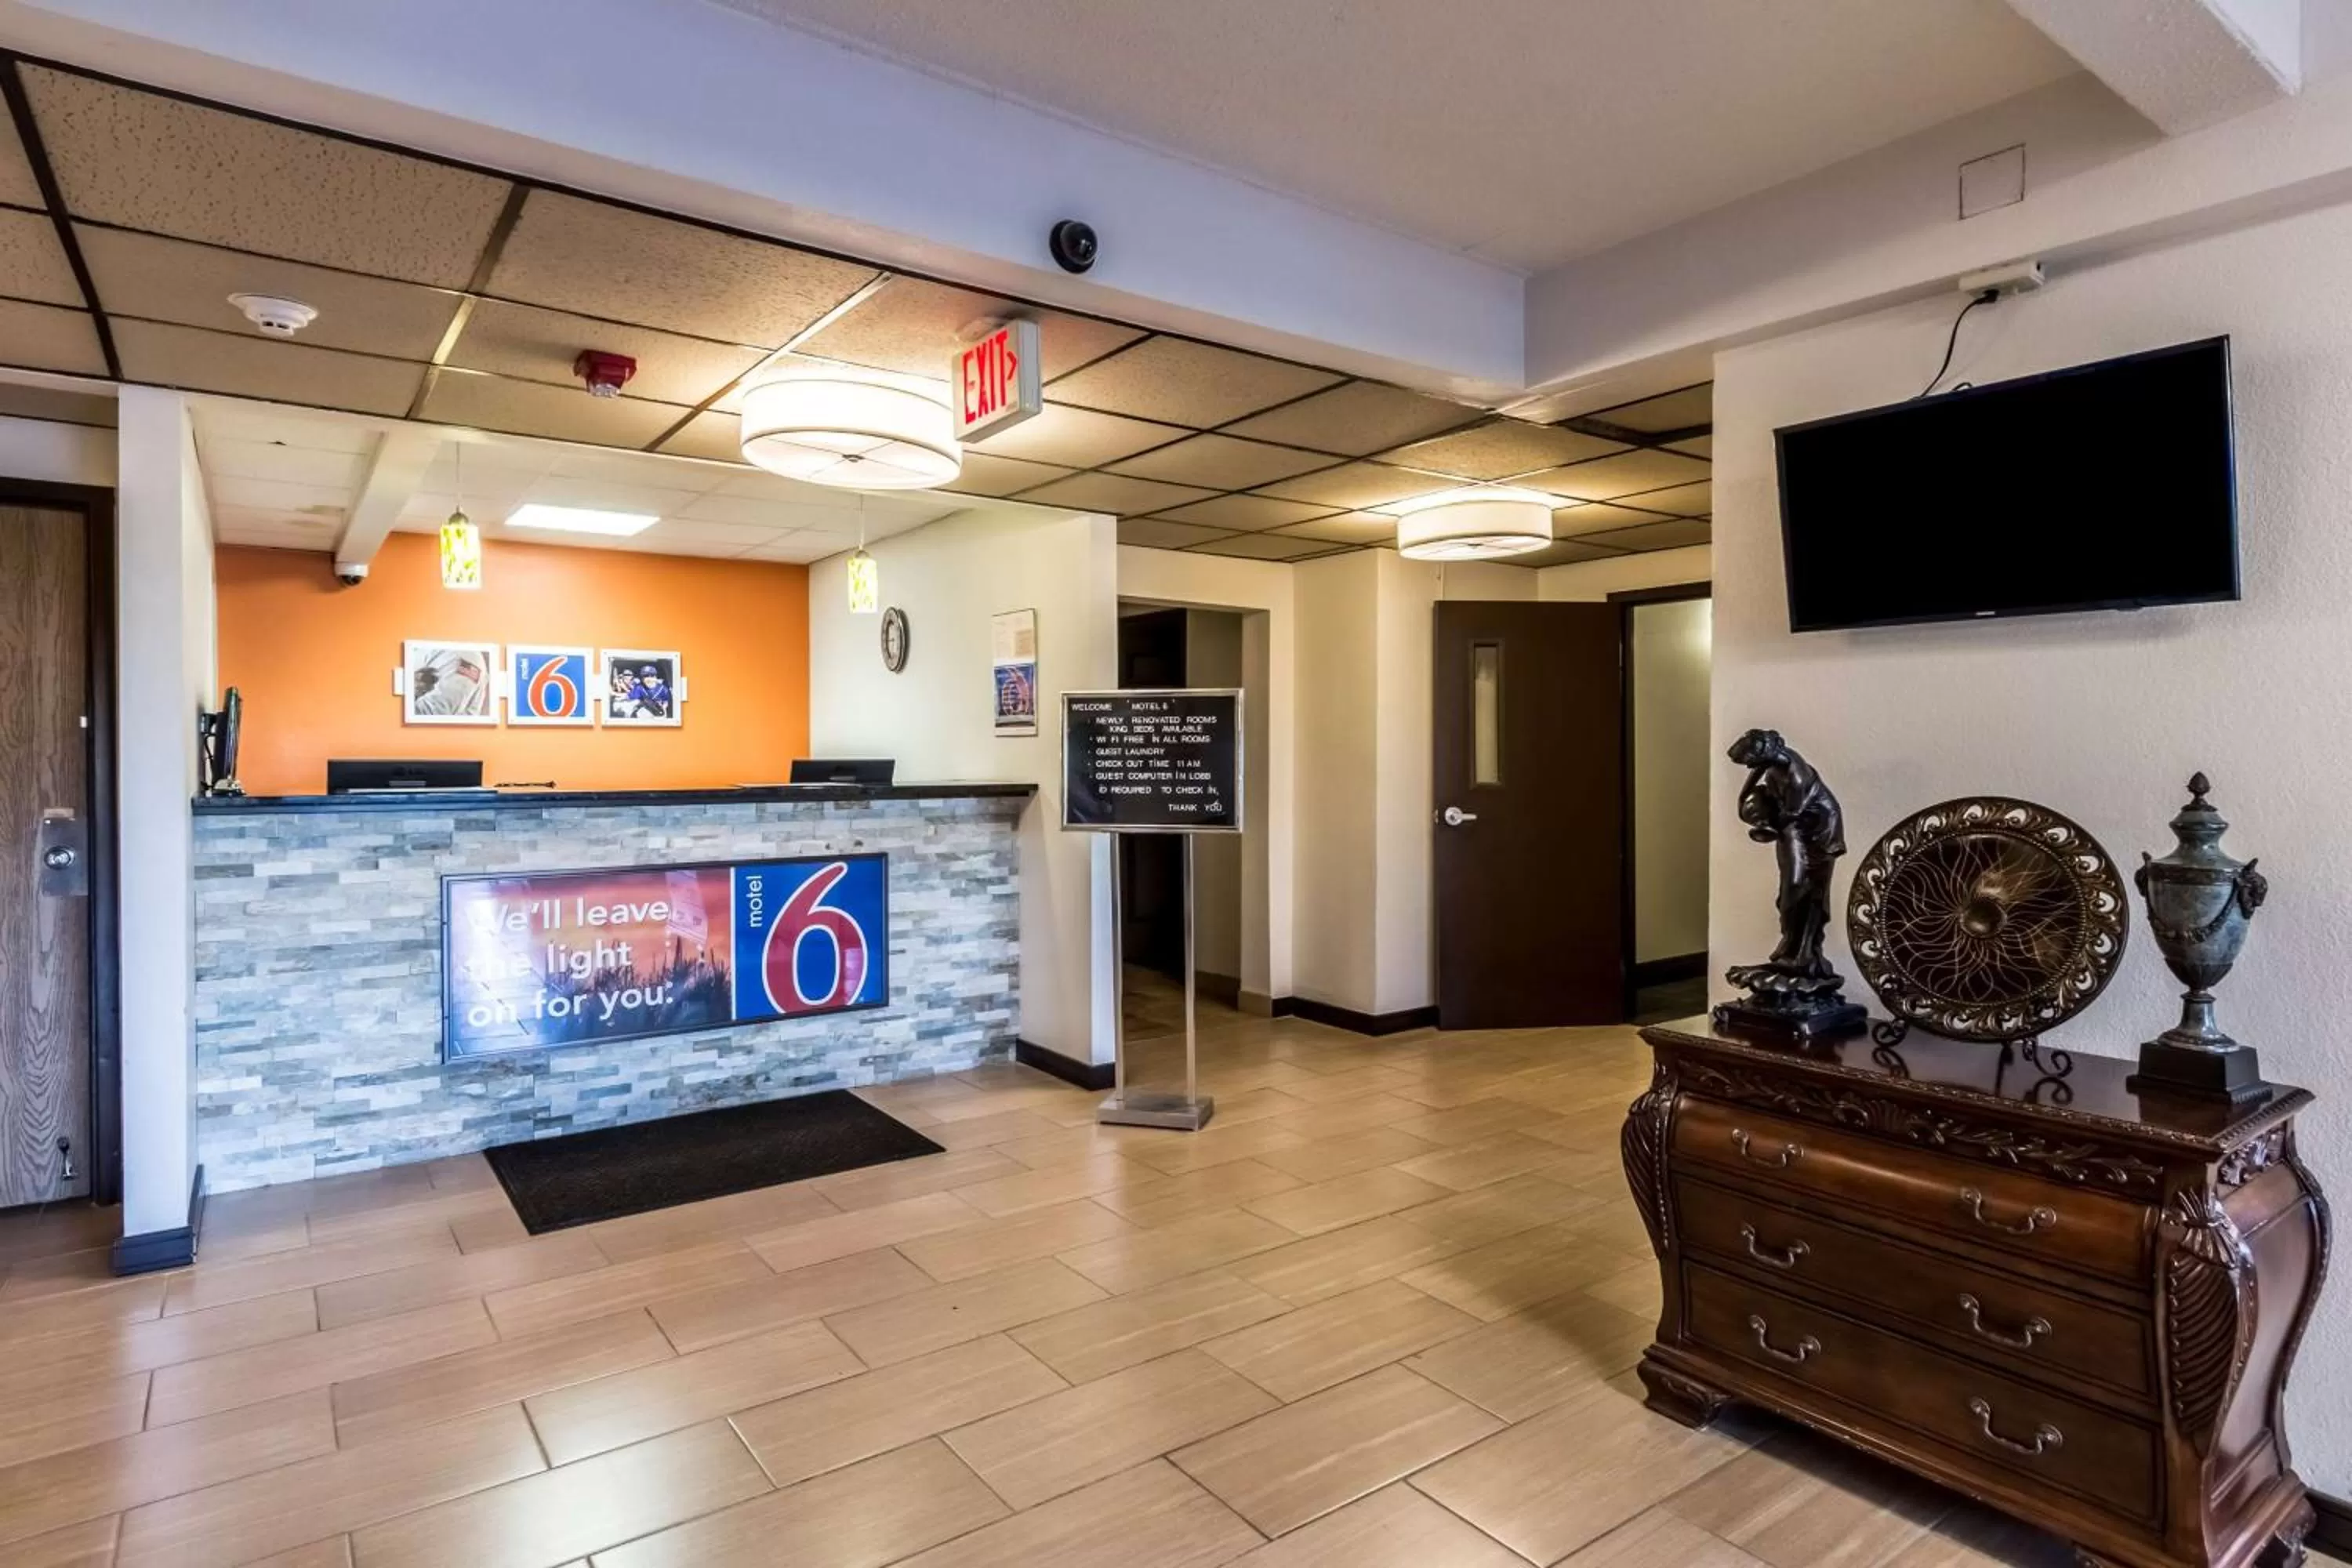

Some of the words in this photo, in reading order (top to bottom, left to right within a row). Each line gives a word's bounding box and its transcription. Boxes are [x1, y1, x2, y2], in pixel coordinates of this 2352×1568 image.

[962, 328, 1009, 424] EXIT
[528, 655, 577, 717] 6
[1072, 702, 1112, 711] WELCOME
[1131, 702, 1160, 710] MOTEL
[1162, 724, 1203, 733] AVAILABLE
[1152, 734, 1160, 743] IN
[1181, 735, 1211, 743] ROOMS
[1125, 747, 1165, 756] LAUNDRY
[1149, 758, 1170, 768] TIME
[1175, 771, 1186, 780] IN
[1111, 786, 1152, 794] REQUIRED
[576, 897, 669, 927] leave
[746, 875, 763, 928] motel
[762, 862, 868, 1014] 6
[548, 940, 632, 980] light
[468, 1003, 517, 1027] on
[530, 988, 587, 1019] for
